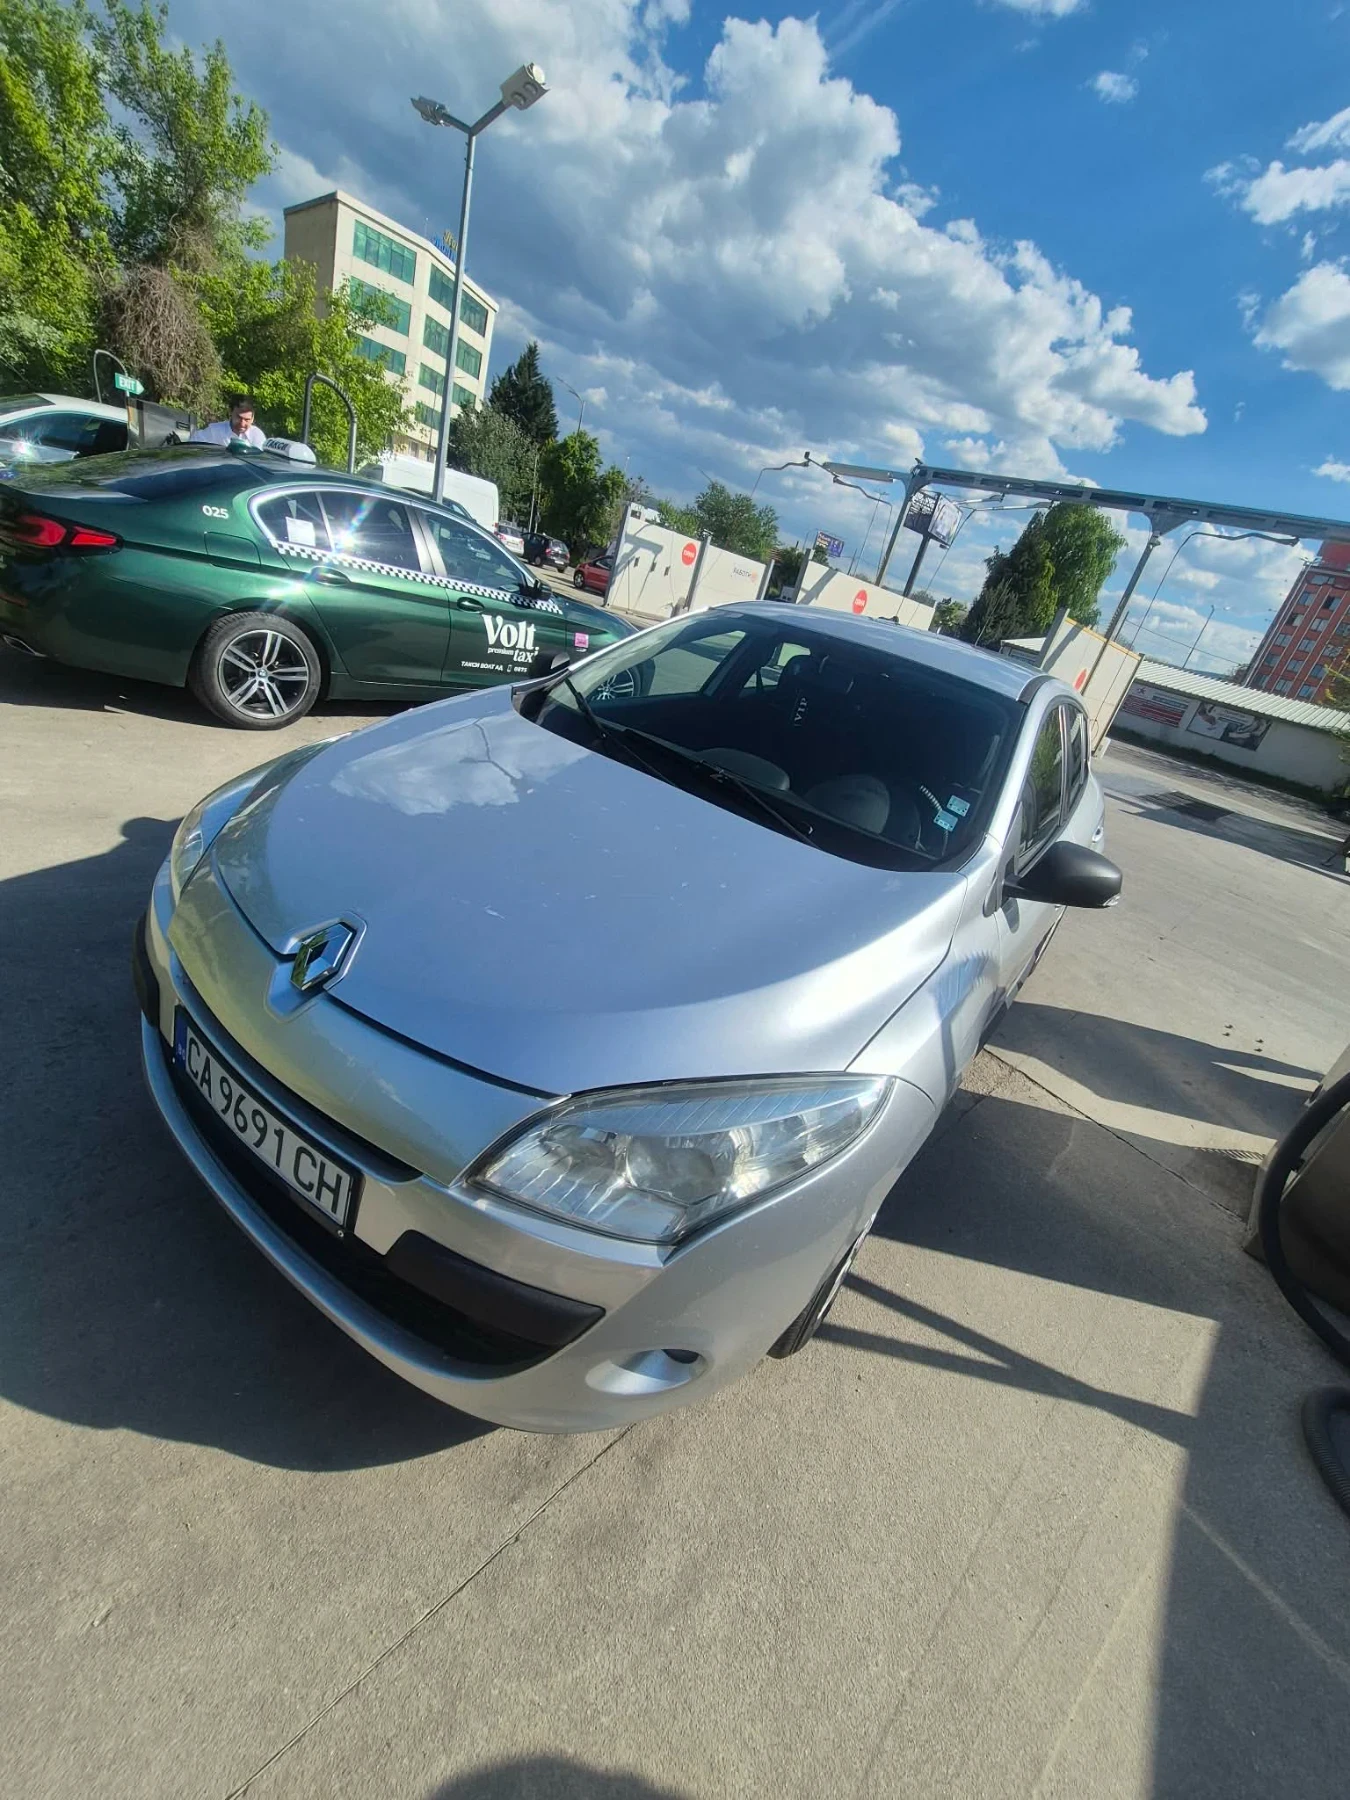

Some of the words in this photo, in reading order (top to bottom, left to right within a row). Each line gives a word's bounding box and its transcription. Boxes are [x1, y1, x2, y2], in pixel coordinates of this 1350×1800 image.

[119, 377, 136, 390] EXIT
[265, 439, 289, 451] ТАКСИ
[202, 505, 229, 519] 025
[488, 647, 514, 655] premium
[188, 1037, 212, 1098] CA
[220, 1076, 284, 1168] 9691
[293, 1146, 342, 1214] CH
